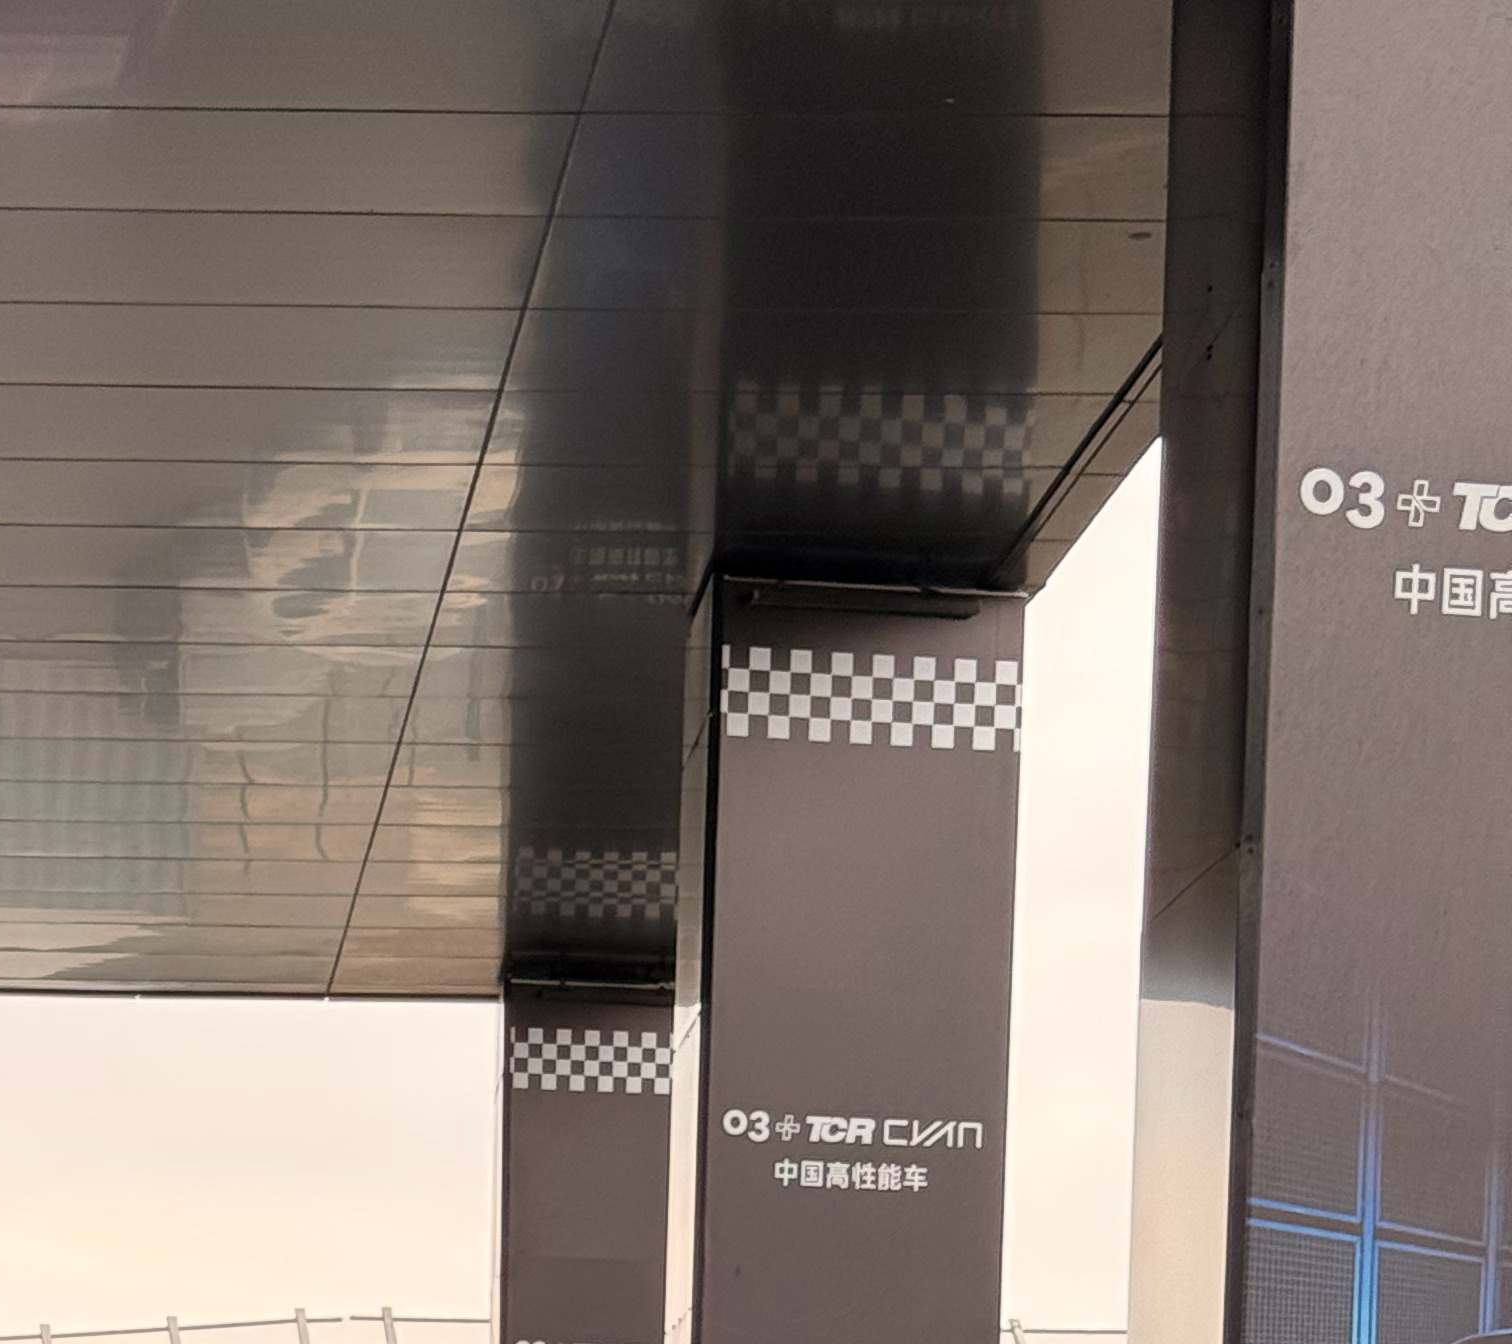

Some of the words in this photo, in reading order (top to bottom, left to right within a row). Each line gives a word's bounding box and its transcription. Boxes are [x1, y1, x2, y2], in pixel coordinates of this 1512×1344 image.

[805, 1115, 876, 1145] TCR
[774, 1158, 928, 1192] 中国高性能车
